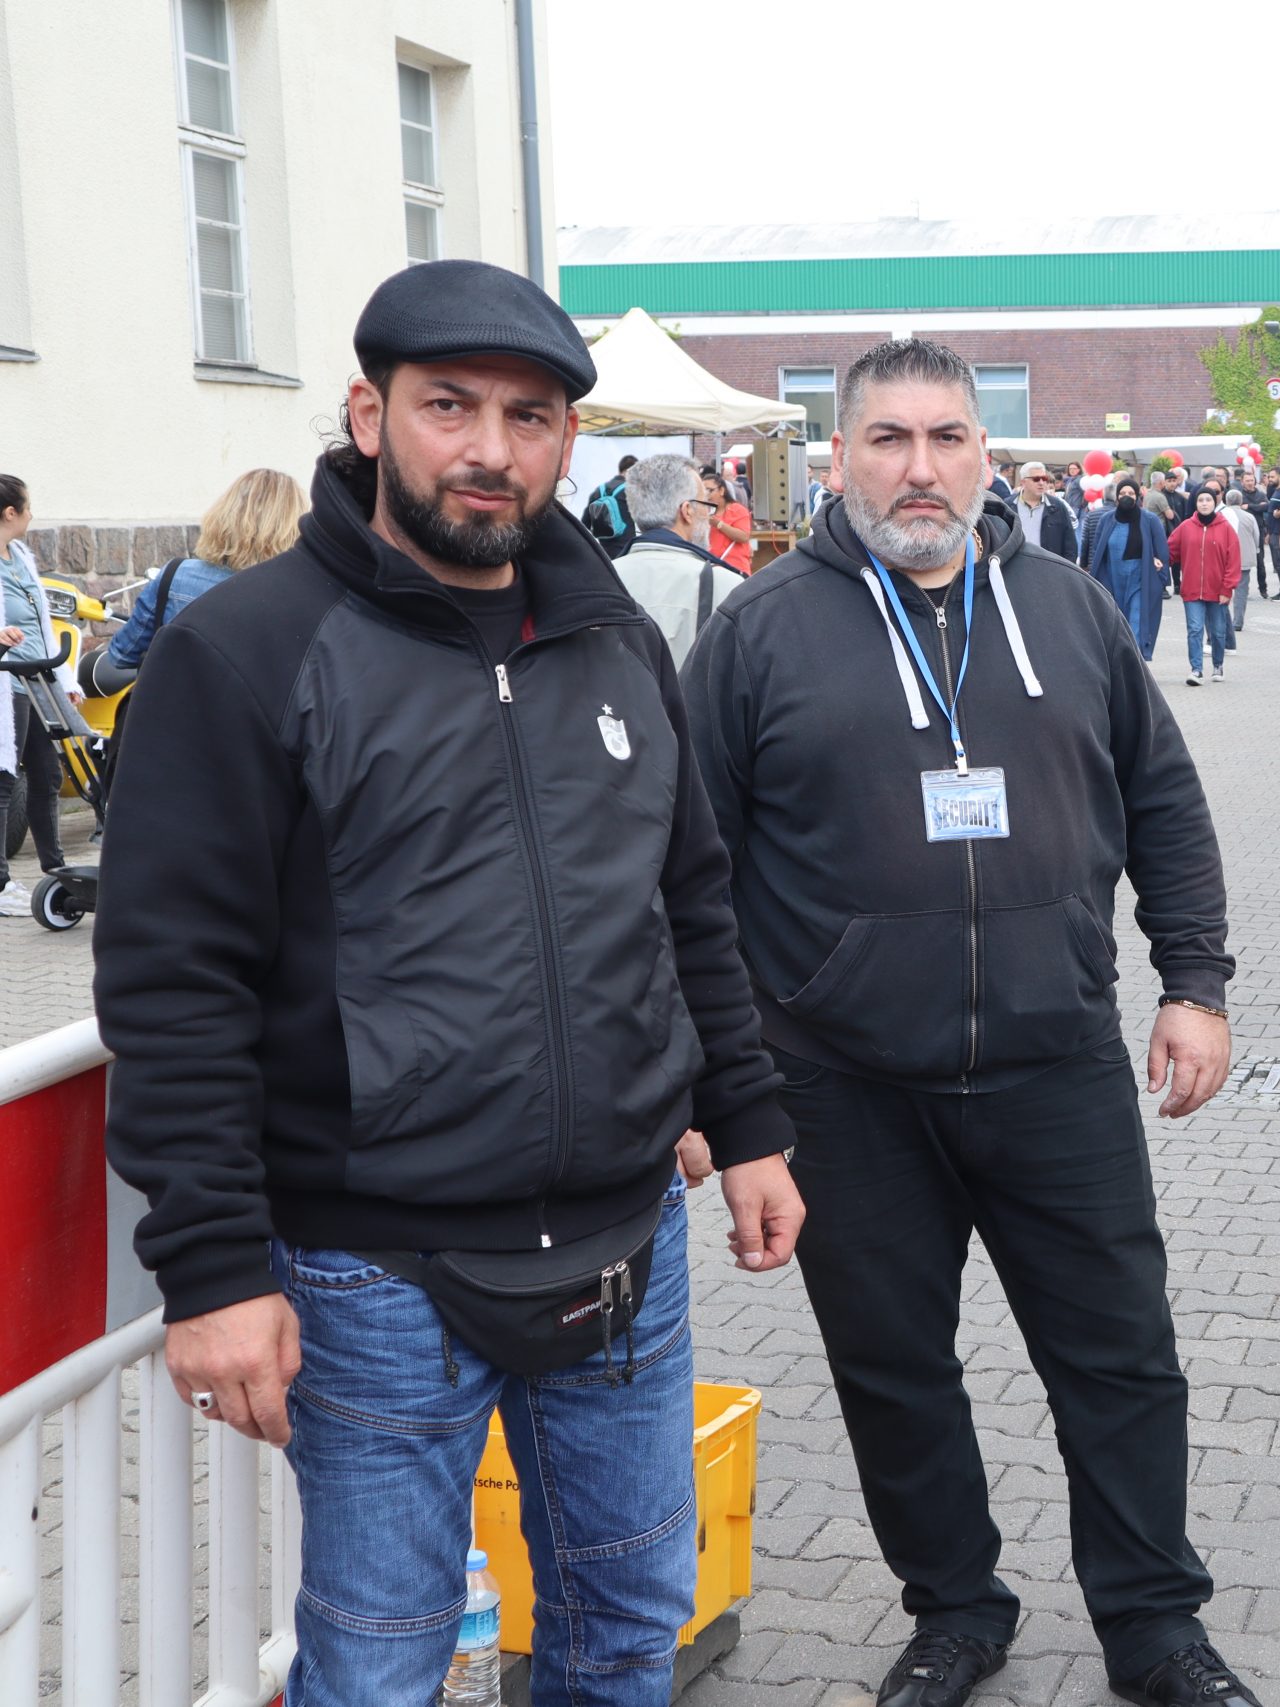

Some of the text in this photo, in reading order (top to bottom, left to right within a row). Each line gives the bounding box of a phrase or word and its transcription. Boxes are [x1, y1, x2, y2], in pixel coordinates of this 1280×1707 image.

[1271, 384, 1279, 396] 5
[933, 797, 999, 830] SECURITY
[474, 1477, 520, 1491] tsche Po
